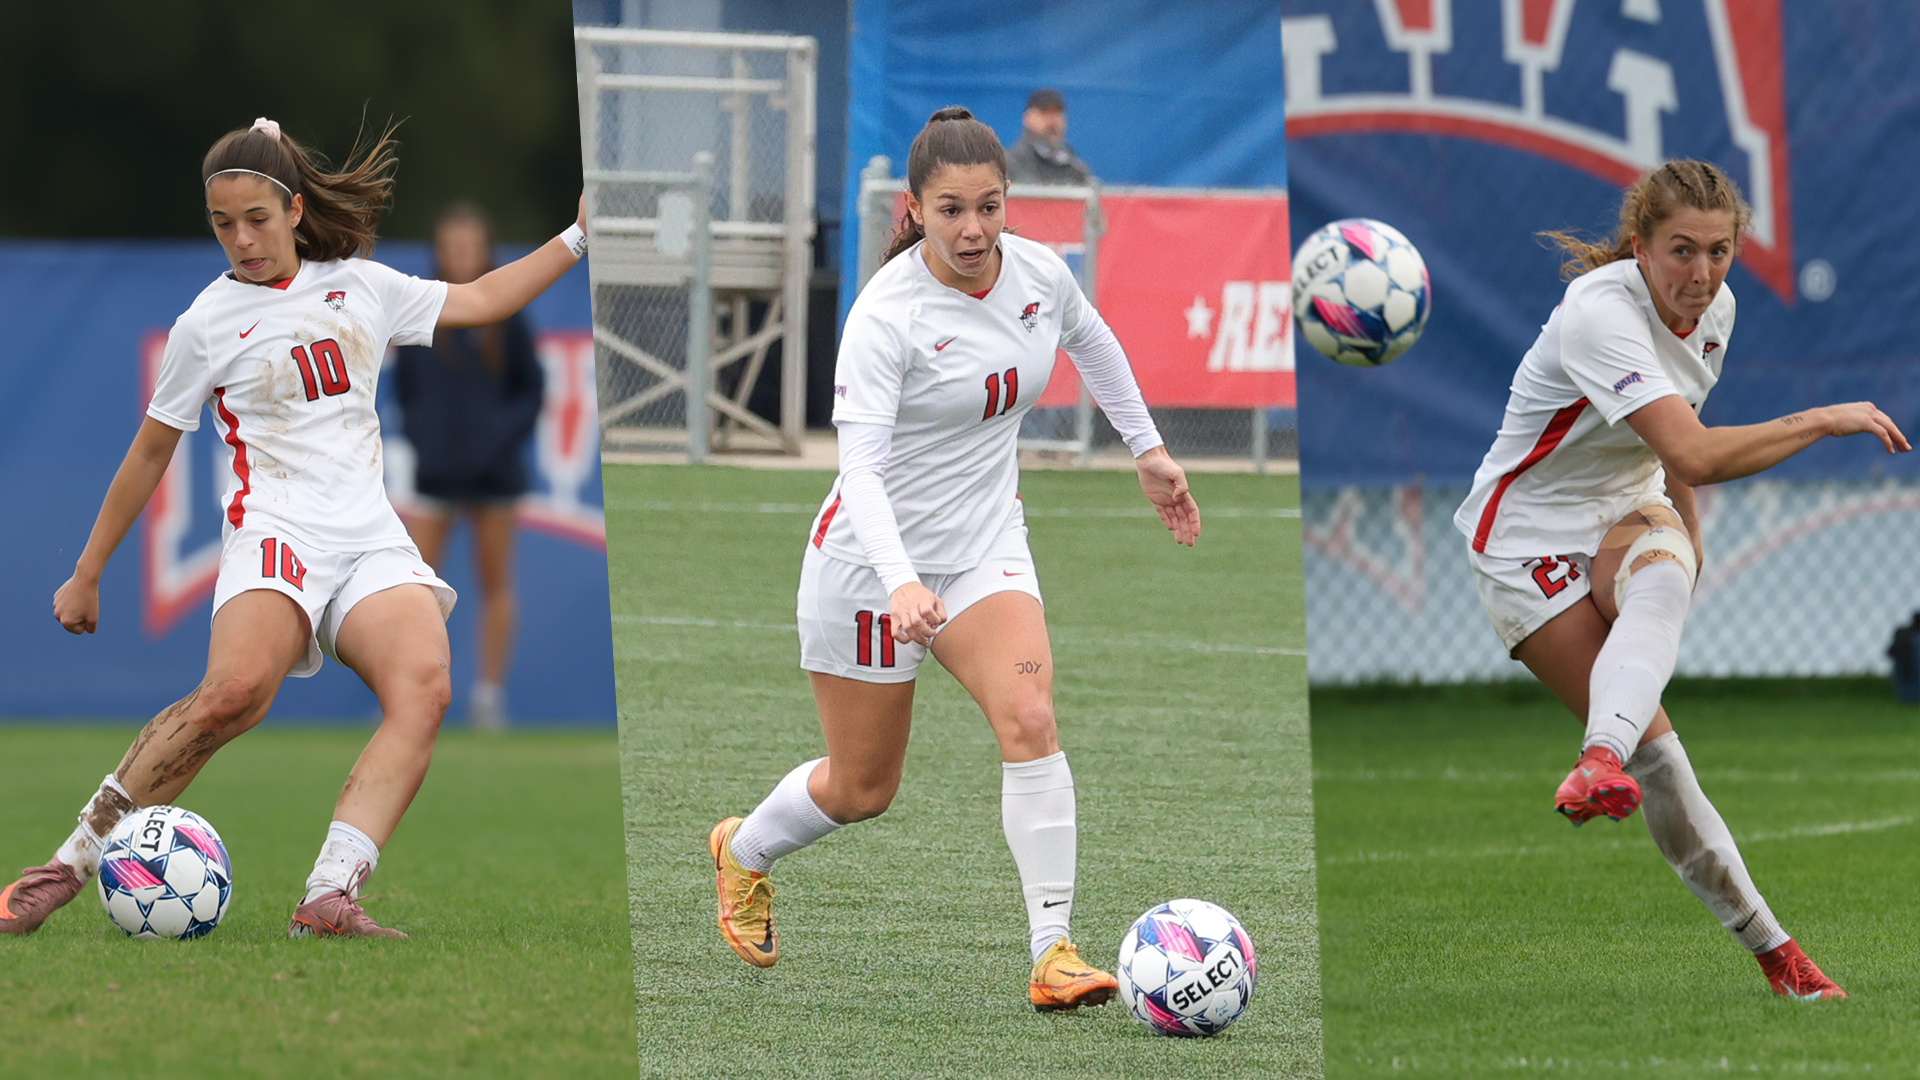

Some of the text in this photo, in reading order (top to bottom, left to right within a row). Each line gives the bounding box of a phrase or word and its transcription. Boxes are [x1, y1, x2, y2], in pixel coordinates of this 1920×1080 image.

[1207, 281, 1295, 371] RE
[290, 338, 351, 402] 10
[982, 366, 1018, 422] 11
[260, 537, 307, 592] 10
[1522, 555, 1581, 600] 21
[855, 609, 896, 668] 11
[1014, 660, 1043, 675] JOY
[1172, 950, 1239, 1011] SELECT
